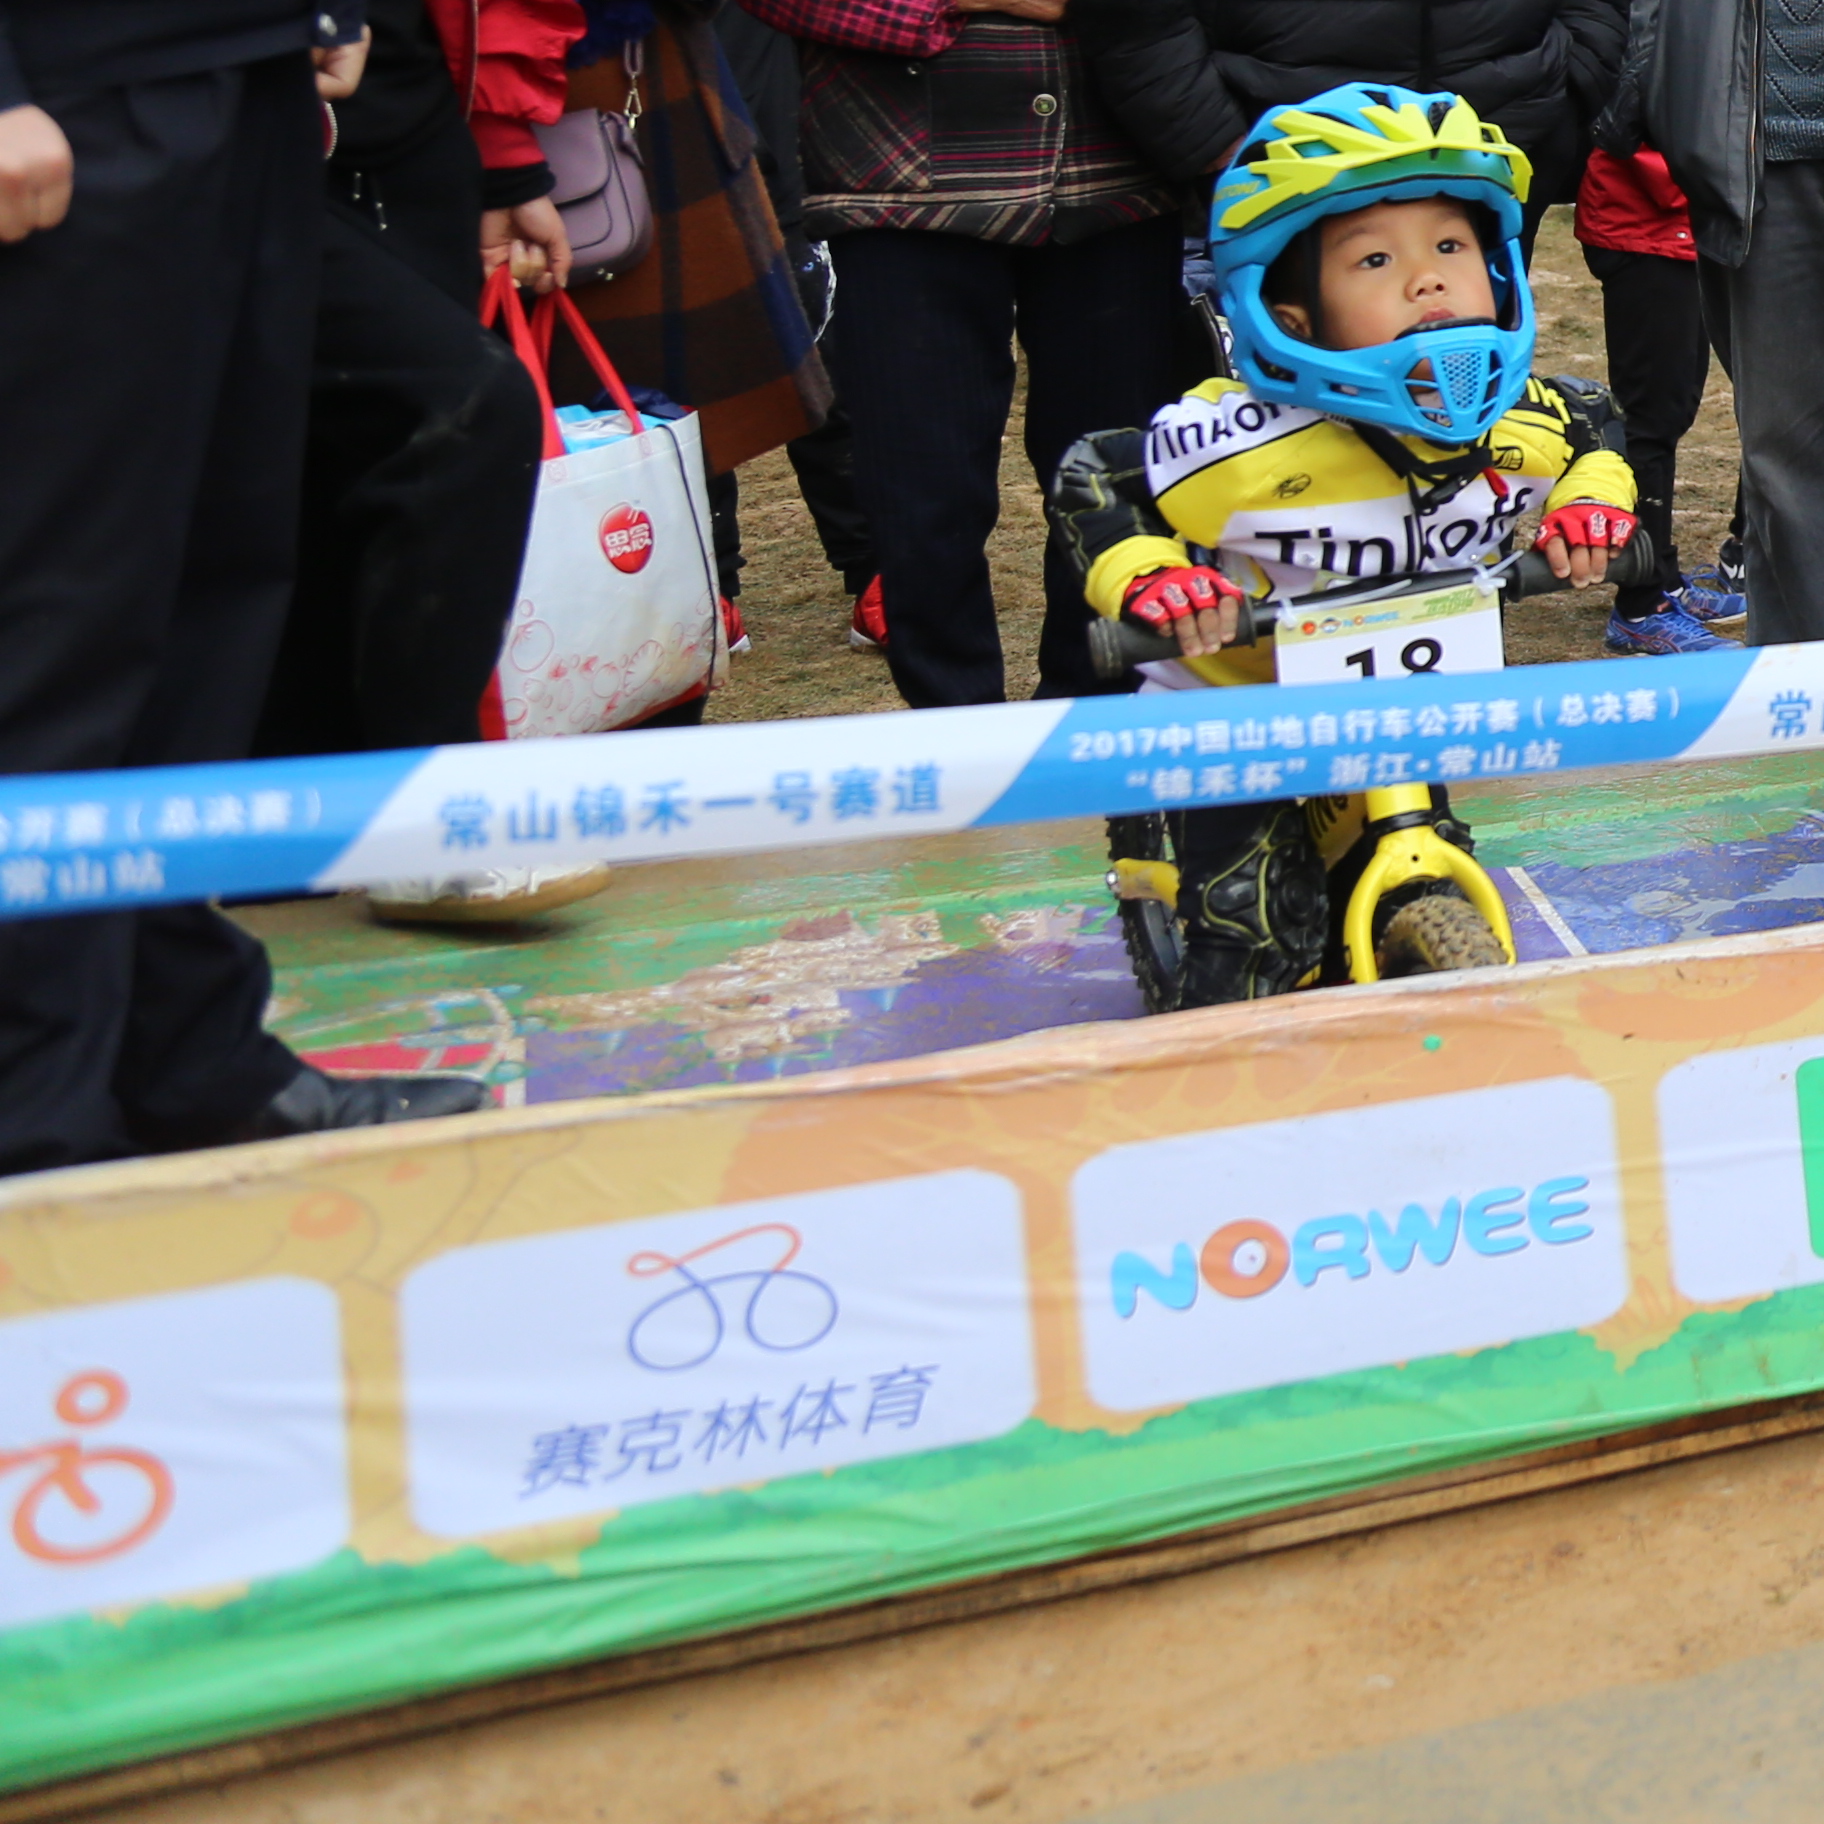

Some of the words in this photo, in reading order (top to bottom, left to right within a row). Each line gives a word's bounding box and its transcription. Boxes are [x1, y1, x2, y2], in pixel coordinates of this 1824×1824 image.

[1070, 688, 1681, 762] 2017中国山地自行车公开赛（总决赛）
[437, 761, 945, 850] 常山锦禾一号赛道
[1110, 1175, 1595, 1318] NORWEE
[517, 1362, 941, 1502] 赛克林体育
